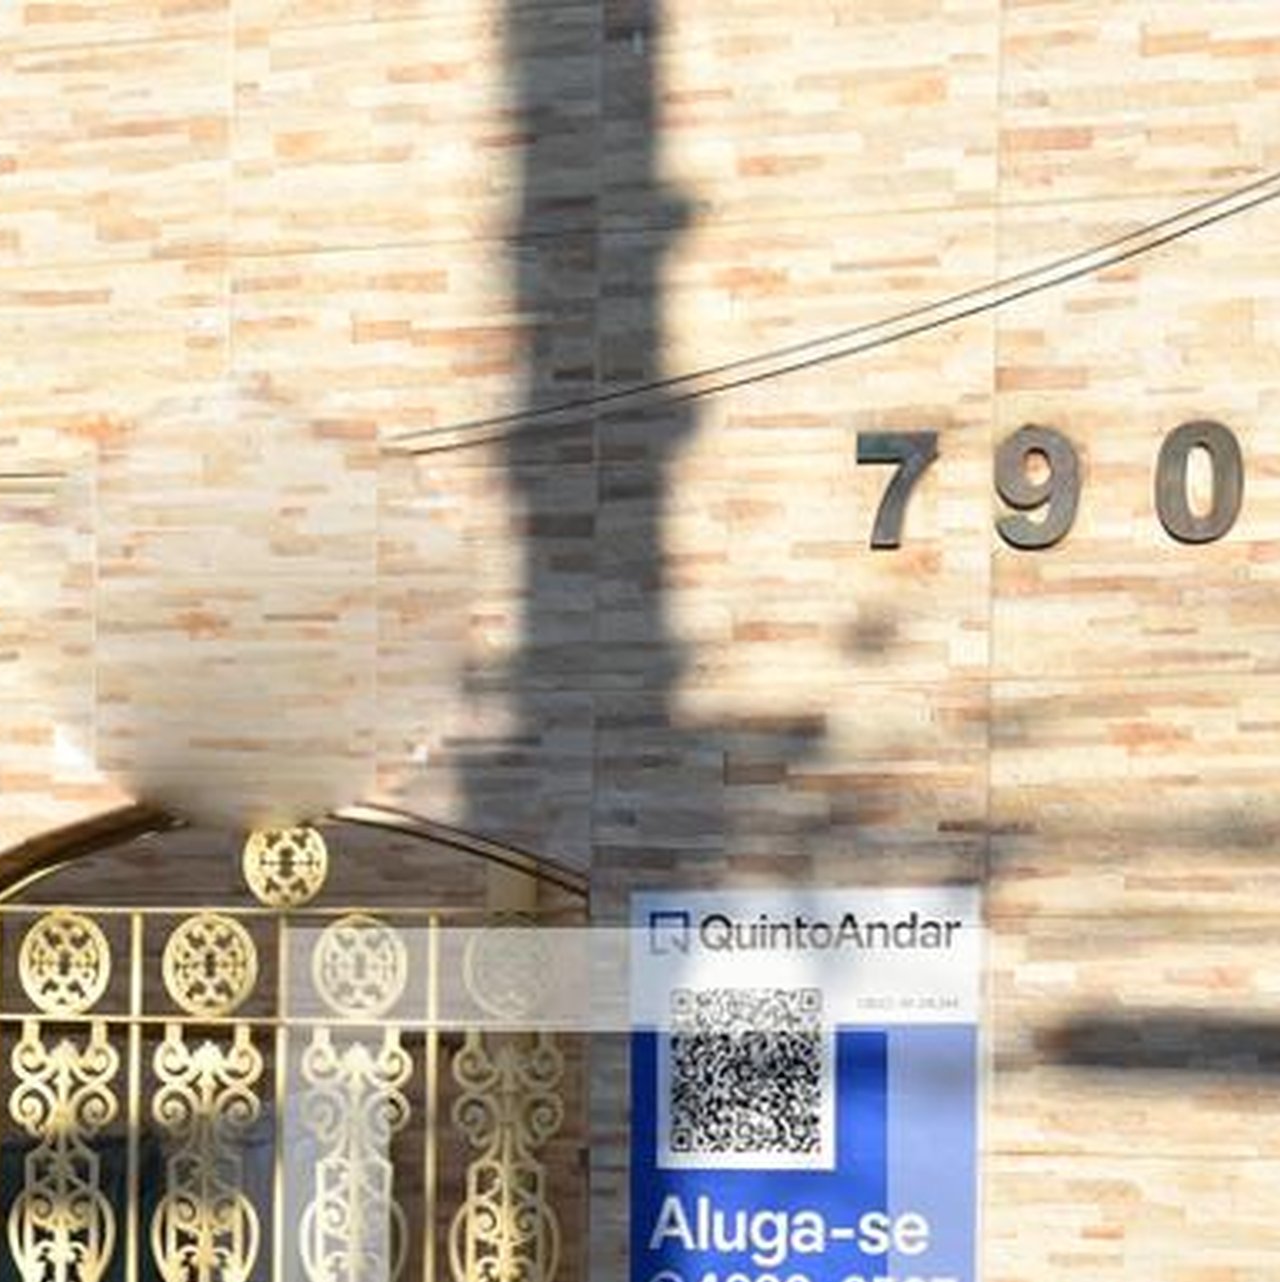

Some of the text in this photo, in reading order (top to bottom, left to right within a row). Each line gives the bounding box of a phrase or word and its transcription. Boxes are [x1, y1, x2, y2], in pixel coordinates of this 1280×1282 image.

[855, 420, 1245, 551] 790
[699, 911, 962, 952] QuintoAndar
[649, 1197, 931, 1267] Aluga-se
